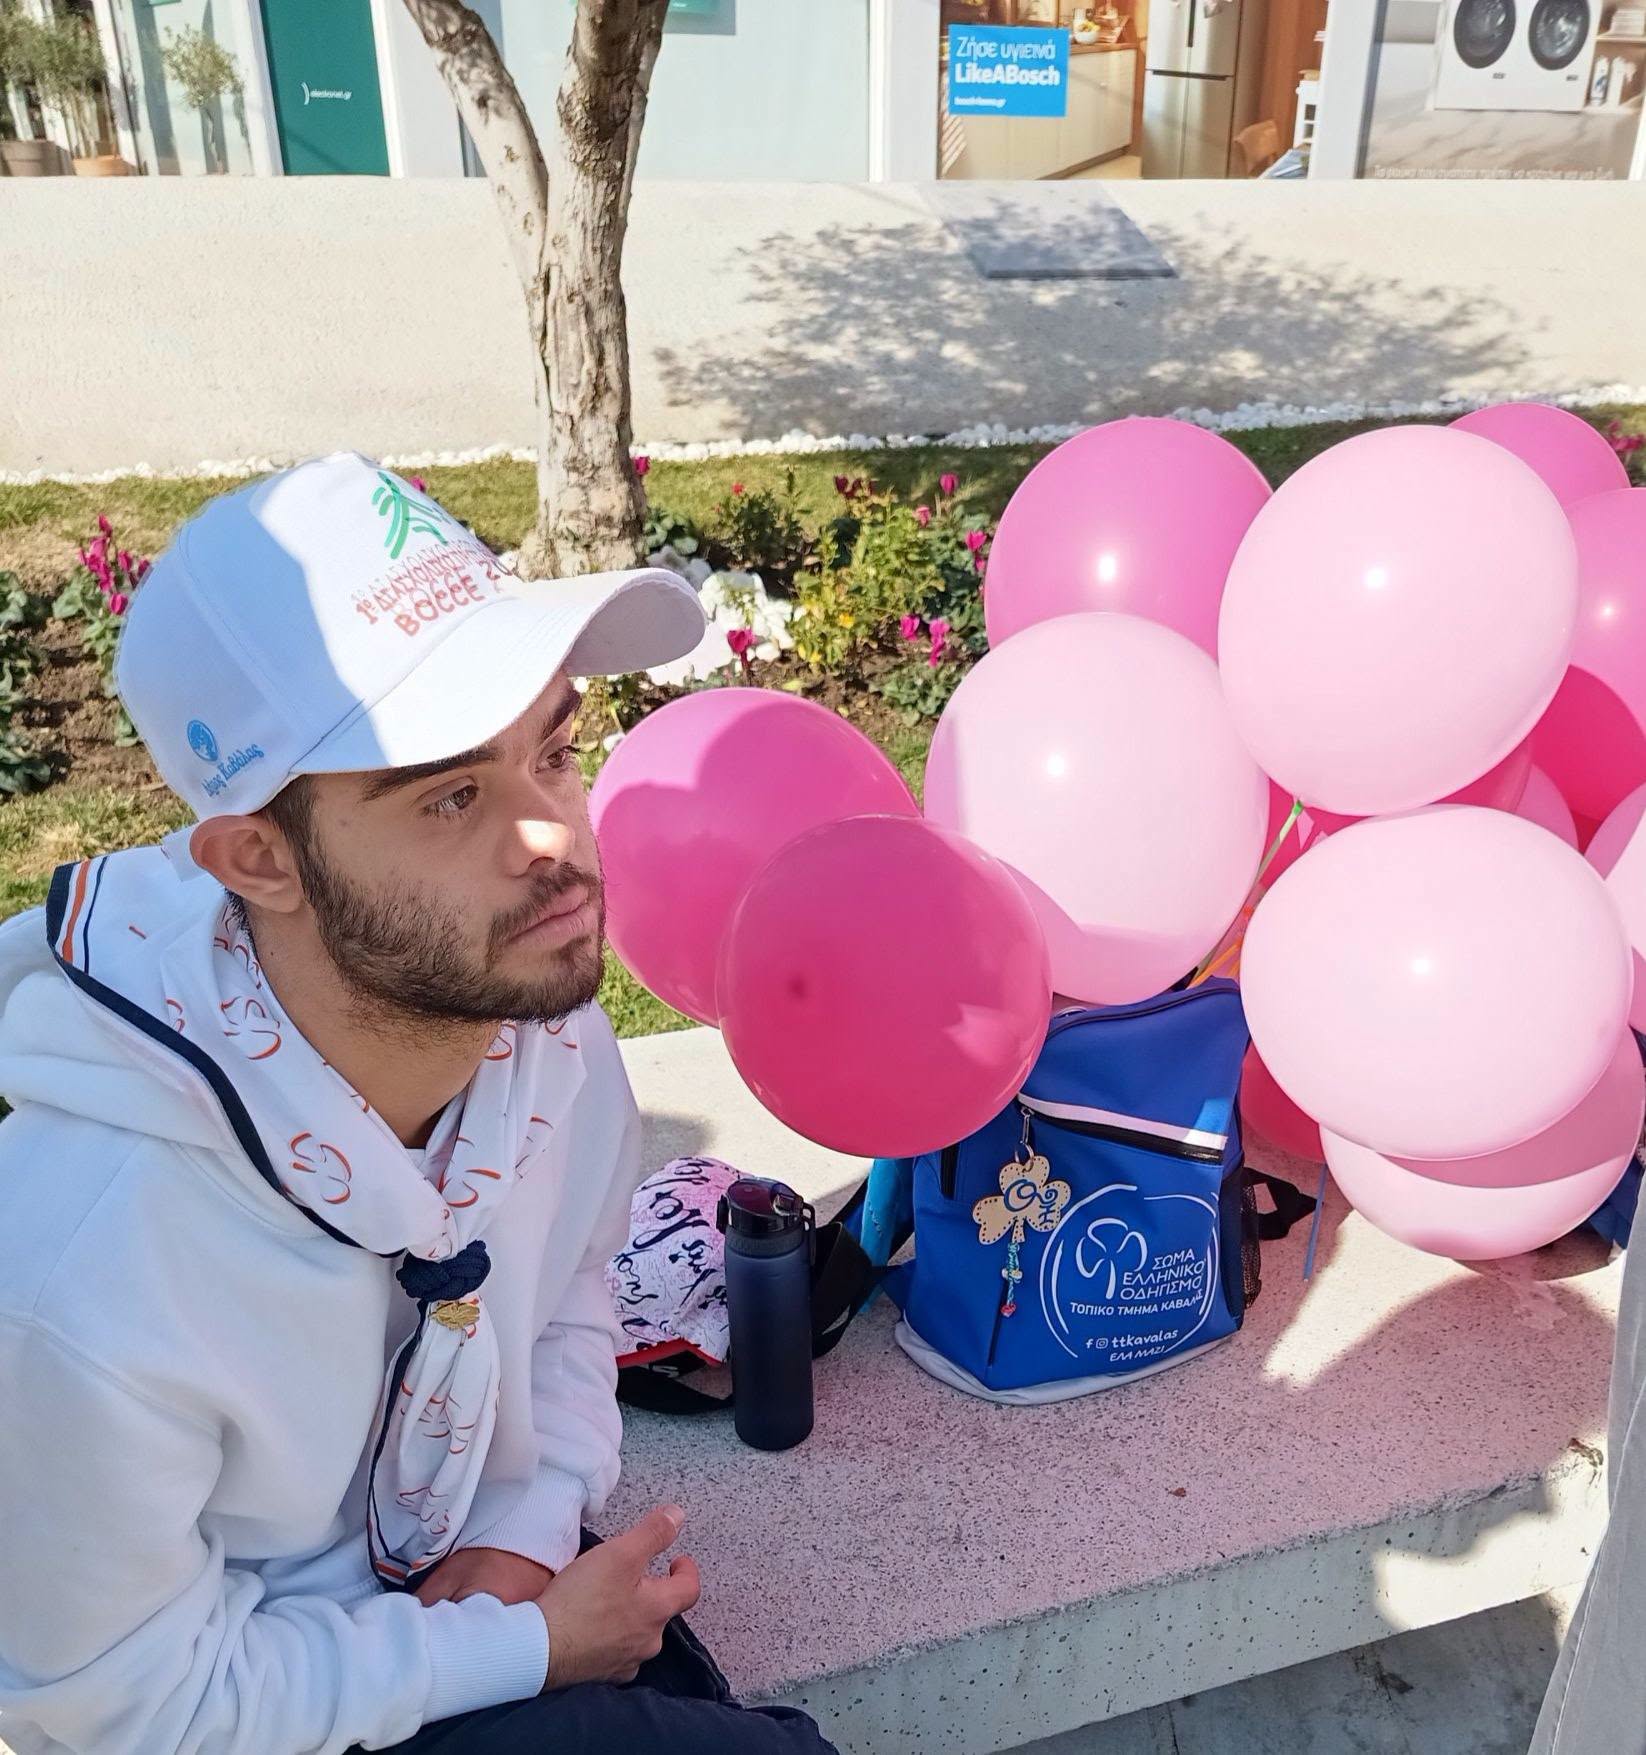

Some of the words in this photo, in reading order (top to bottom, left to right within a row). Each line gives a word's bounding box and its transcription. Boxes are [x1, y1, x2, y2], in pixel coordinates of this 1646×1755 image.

[956, 36, 998, 61] Ζήσε
[955, 61, 1061, 86] LikeABosch
[1122, 1257, 1207, 1286] ΕΛΛΗΝΙΚΟ
[1152, 1248, 1195, 1271] ΣΩΜΑ
[1070, 1302, 1114, 1316] ΤΟΠΙΚΟ
[1117, 1303, 1158, 1316] ΤΜΗΜΑ
[1111, 1329, 1179, 1348] ttkavalas
